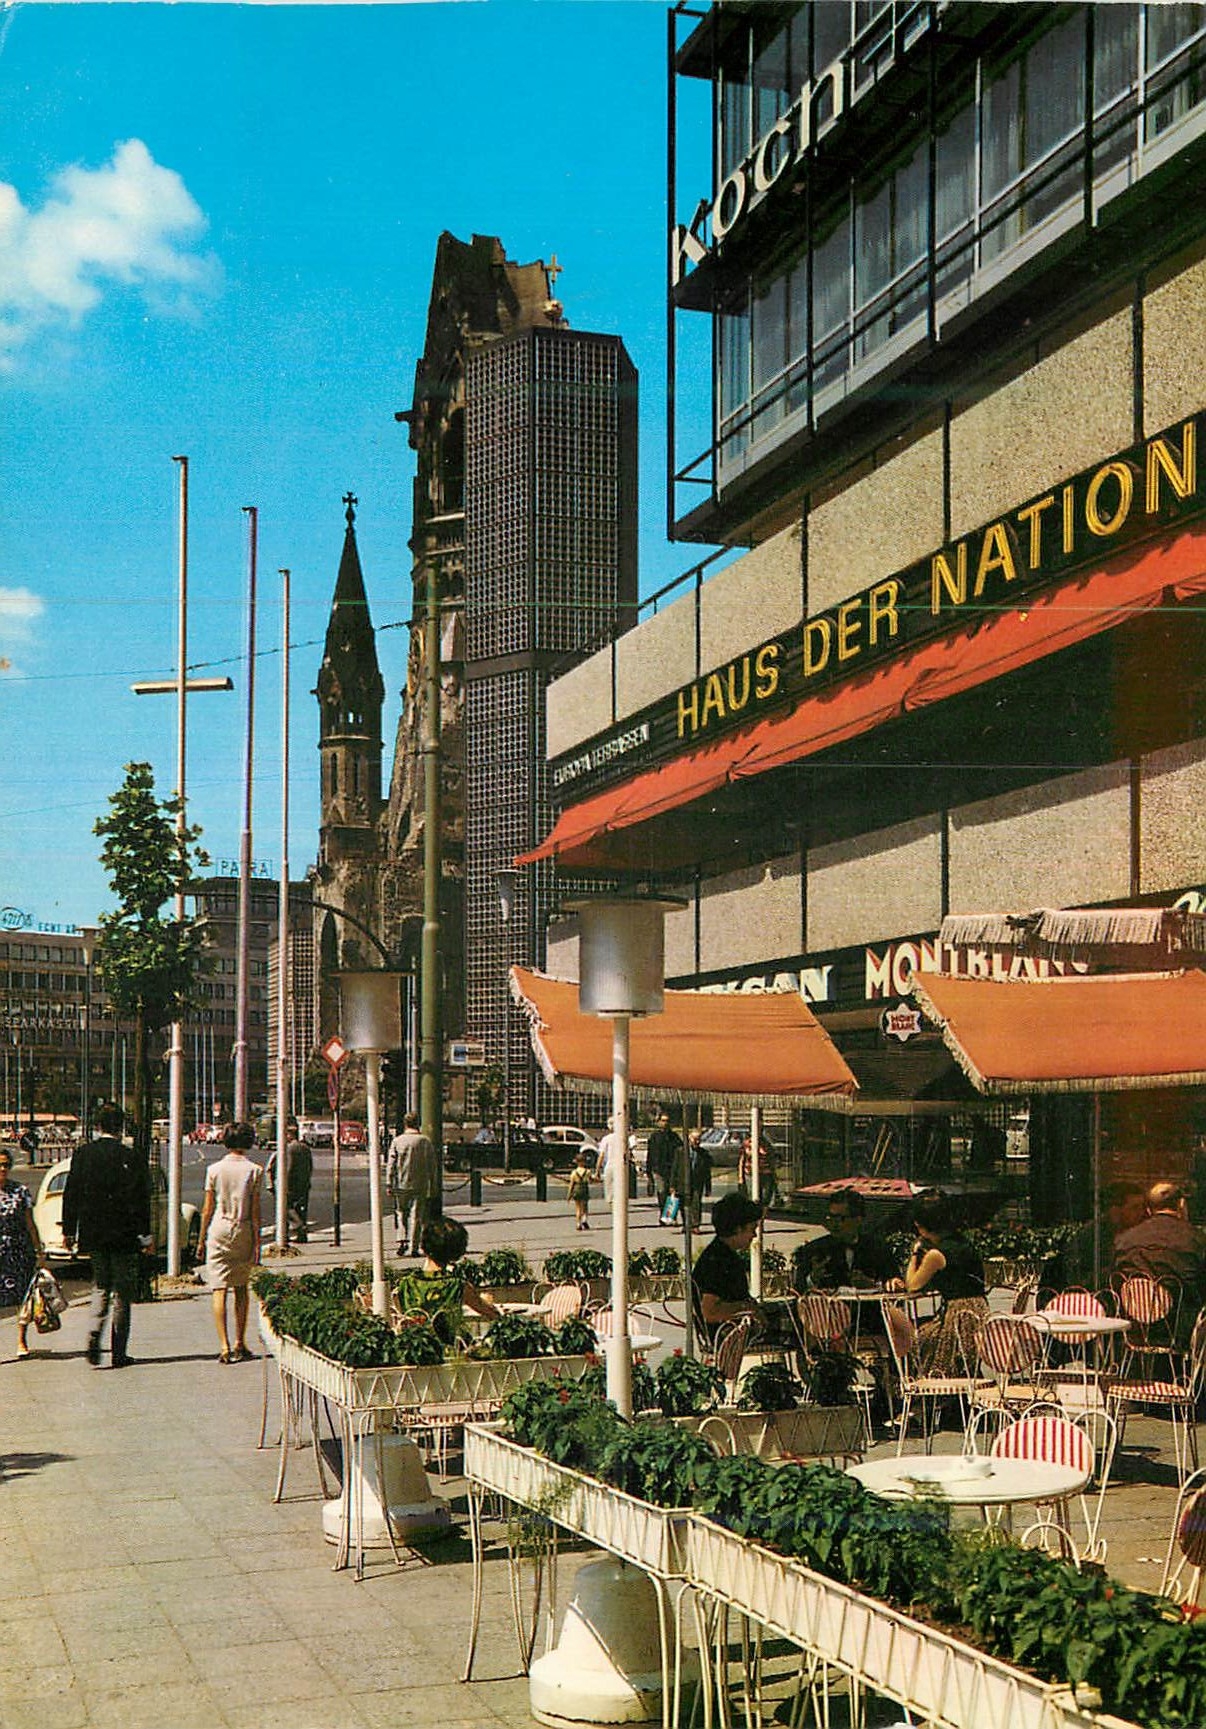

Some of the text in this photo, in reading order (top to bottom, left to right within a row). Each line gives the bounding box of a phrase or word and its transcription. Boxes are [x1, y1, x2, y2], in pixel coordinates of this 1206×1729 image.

[677, 421, 1197, 738] HAUS DER NATION
[865, 937, 1090, 1000] MONTBLA
